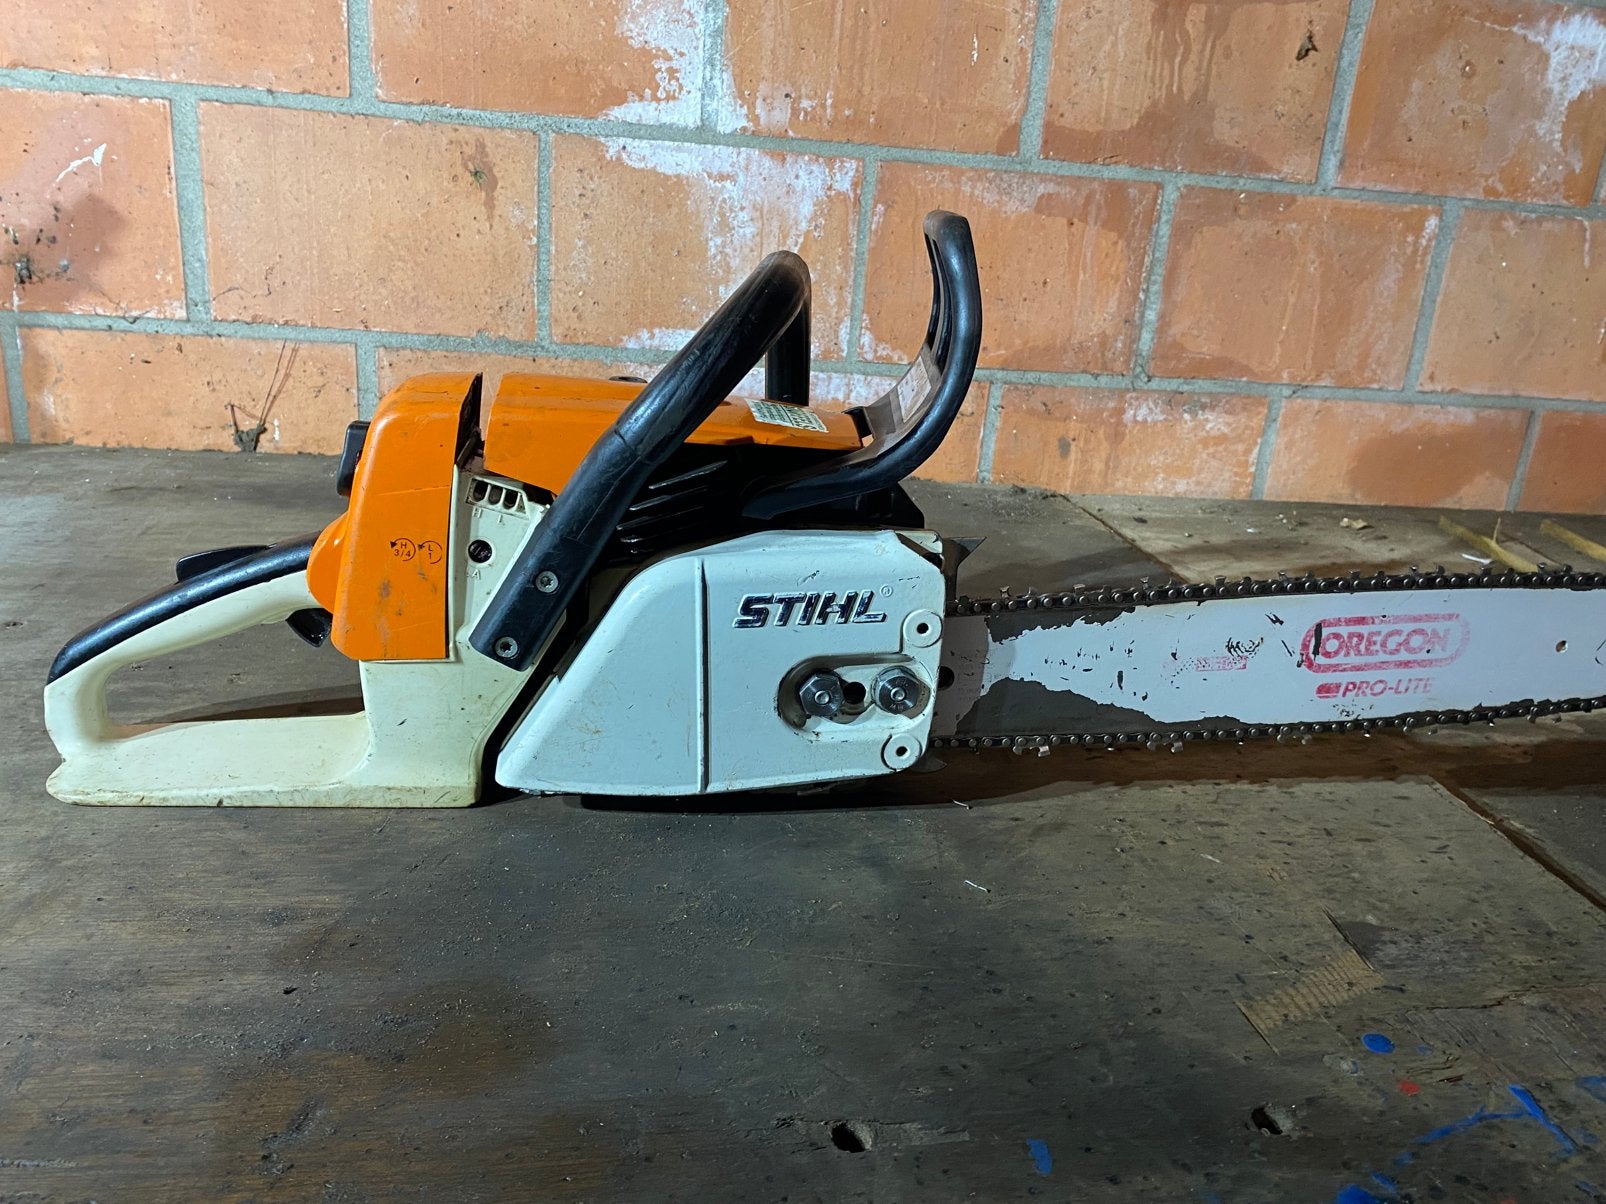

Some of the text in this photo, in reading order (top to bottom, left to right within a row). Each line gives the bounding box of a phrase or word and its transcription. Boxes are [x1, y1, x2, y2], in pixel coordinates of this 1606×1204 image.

[394, 549, 411, 557] 3/4
[428, 544, 433, 552] L
[732, 590, 887, 628] STIHL
[1320, 628, 1450, 659] OREGON
[1341, 677, 1433, 698] PRO-LITE
